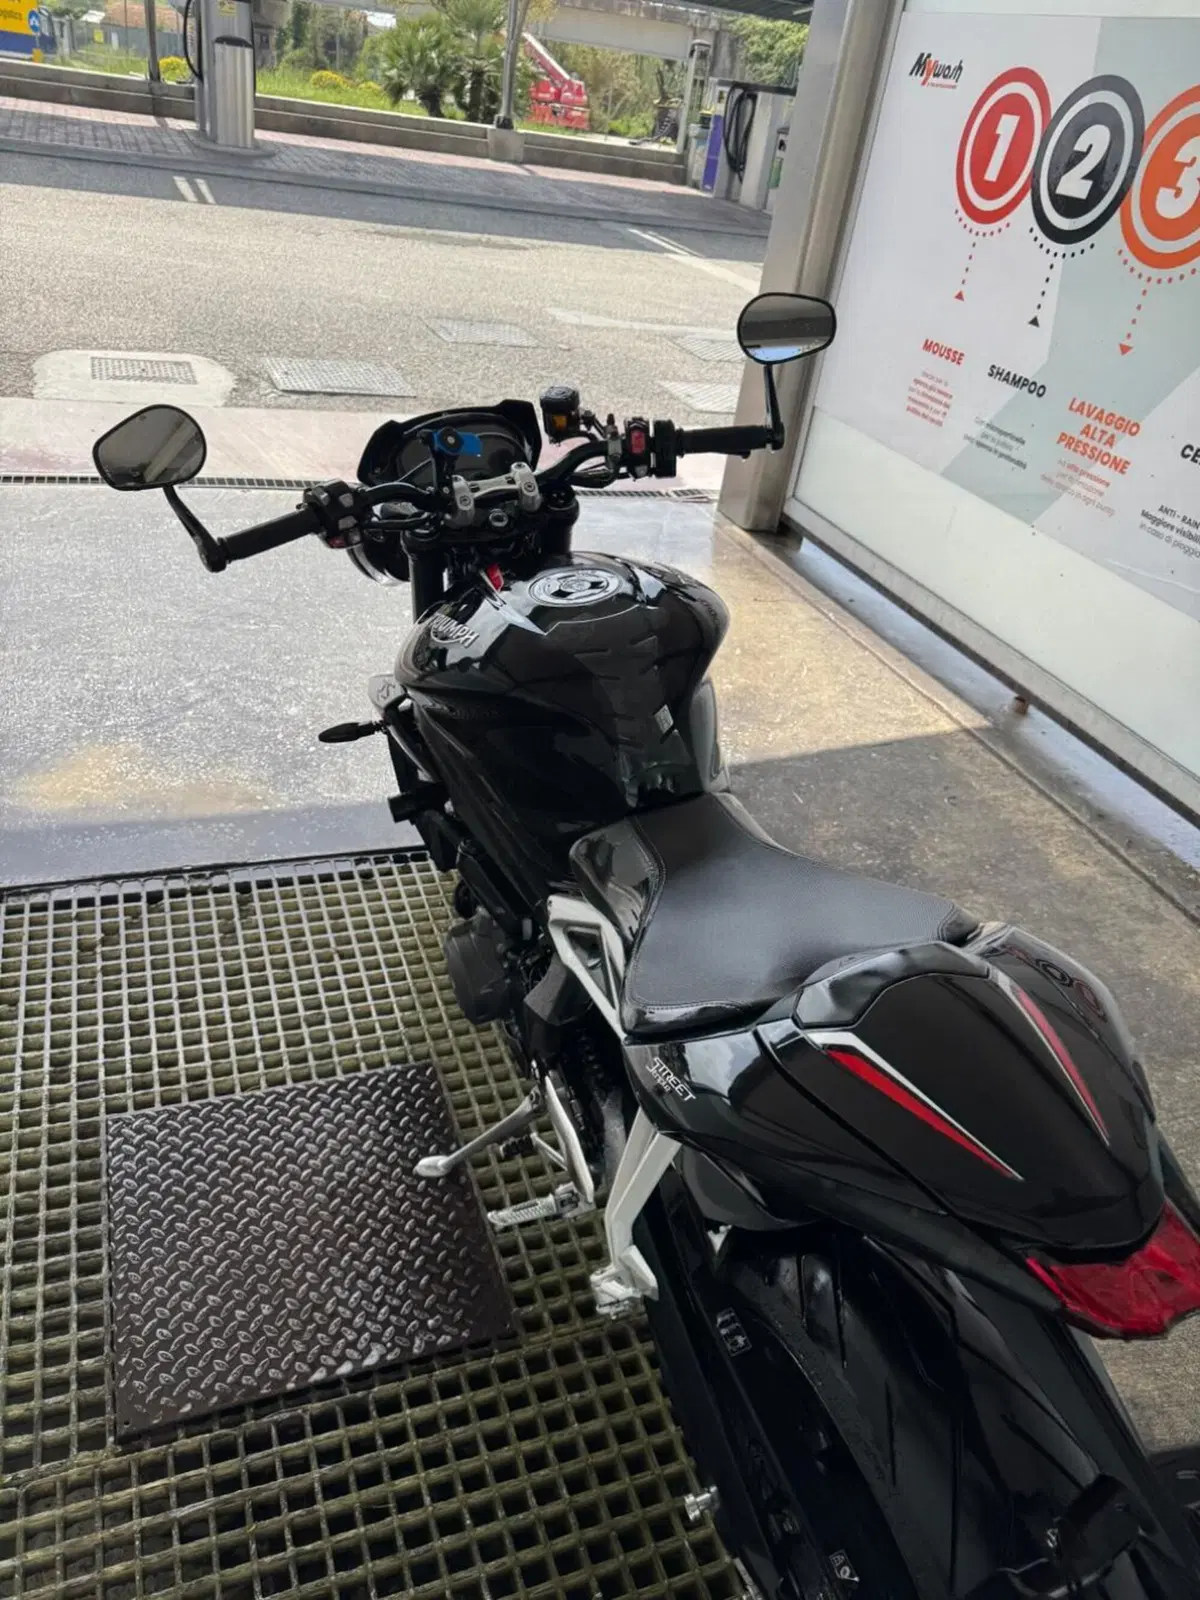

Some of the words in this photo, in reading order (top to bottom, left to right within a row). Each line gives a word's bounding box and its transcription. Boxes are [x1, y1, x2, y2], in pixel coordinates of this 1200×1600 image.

[984, 113, 1021, 182] 1
[1055, 124, 1111, 200] 2
[1155, 136, 1200, 220] 3
[922, 338, 965, 366] MOUSSE
[987, 364, 1047, 398] SHAMPOO
[1068, 397, 1141, 437] LAVAGGIO
[1056, 431, 1131, 475] PRESSIONE
[1079, 423, 1116, 449] ALTA
[1141, 509, 1175, 532] Maggiore
[1158, 504, 1176, 517] ANTI
[645, 1056, 696, 1101] STREET
